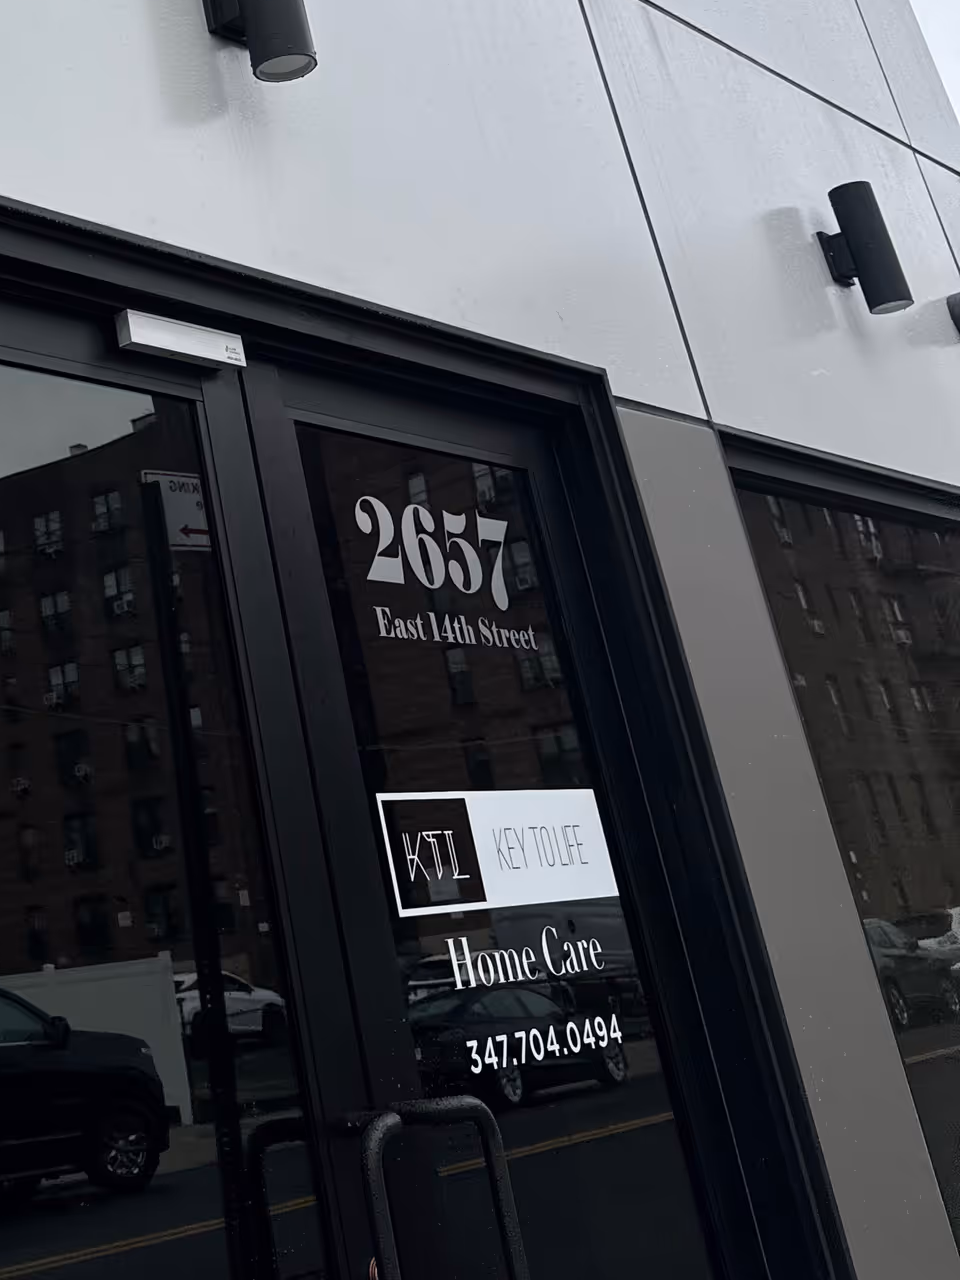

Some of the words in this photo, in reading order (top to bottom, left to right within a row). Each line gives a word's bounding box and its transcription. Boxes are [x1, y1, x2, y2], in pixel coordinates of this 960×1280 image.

[354, 495, 509, 611] 2657
[372, 605, 427, 641] East
[426, 611, 477, 645] 14th
[478, 616, 539, 651] Street
[401, 830, 471, 882] KTL
[492, 824, 528, 870] KEY
[528, 825, 555, 868] TO
[552, 824, 589, 867] LIFE
[444, 936, 538, 991] Home
[541, 925, 605, 976] Care
[466, 1013, 622, 1074] 347.704.0494
